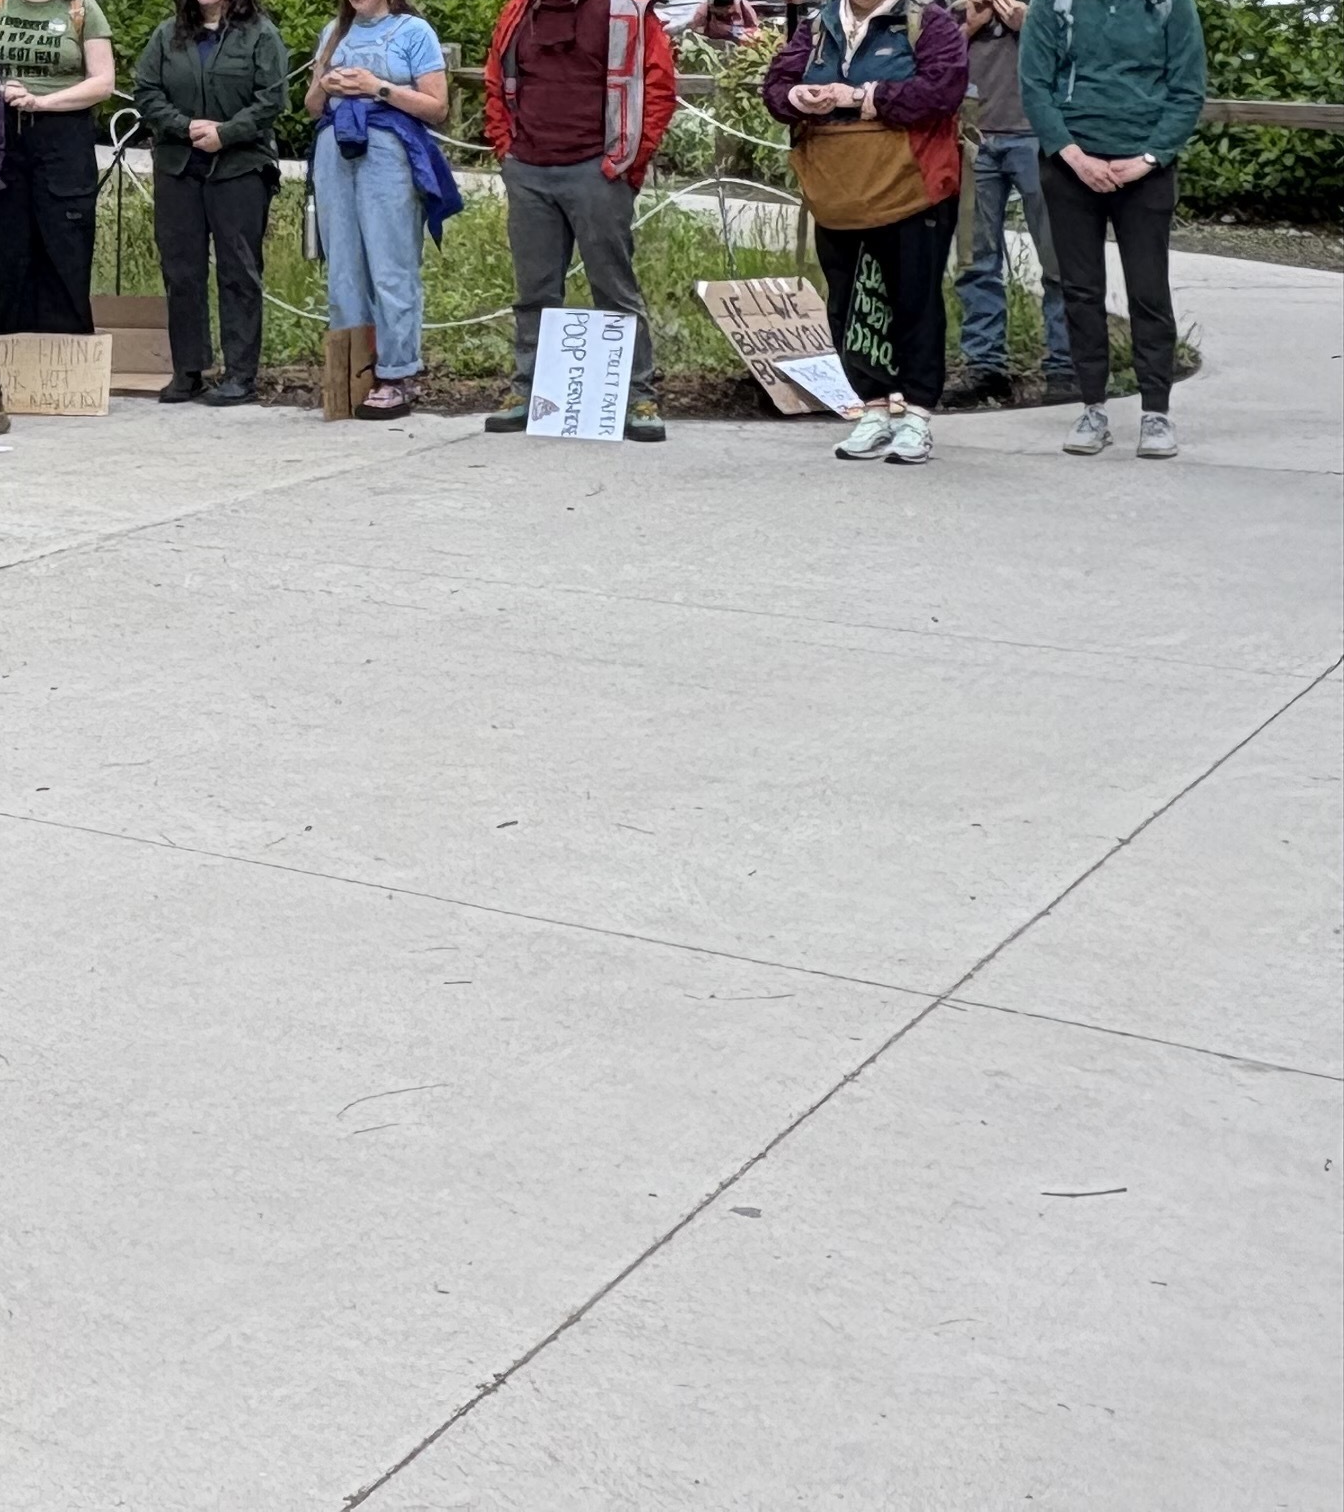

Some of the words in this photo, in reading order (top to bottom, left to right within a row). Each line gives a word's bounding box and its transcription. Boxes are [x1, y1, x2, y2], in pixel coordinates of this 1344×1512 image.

[601, 314, 626, 341] NO
[720, 297, 751, 329] IF
[561, 312, 590, 361] POOP
[731, 327, 797, 356] BURN
[786, 323, 834, 352] YOU
[598, 392, 618, 436] PAPER
